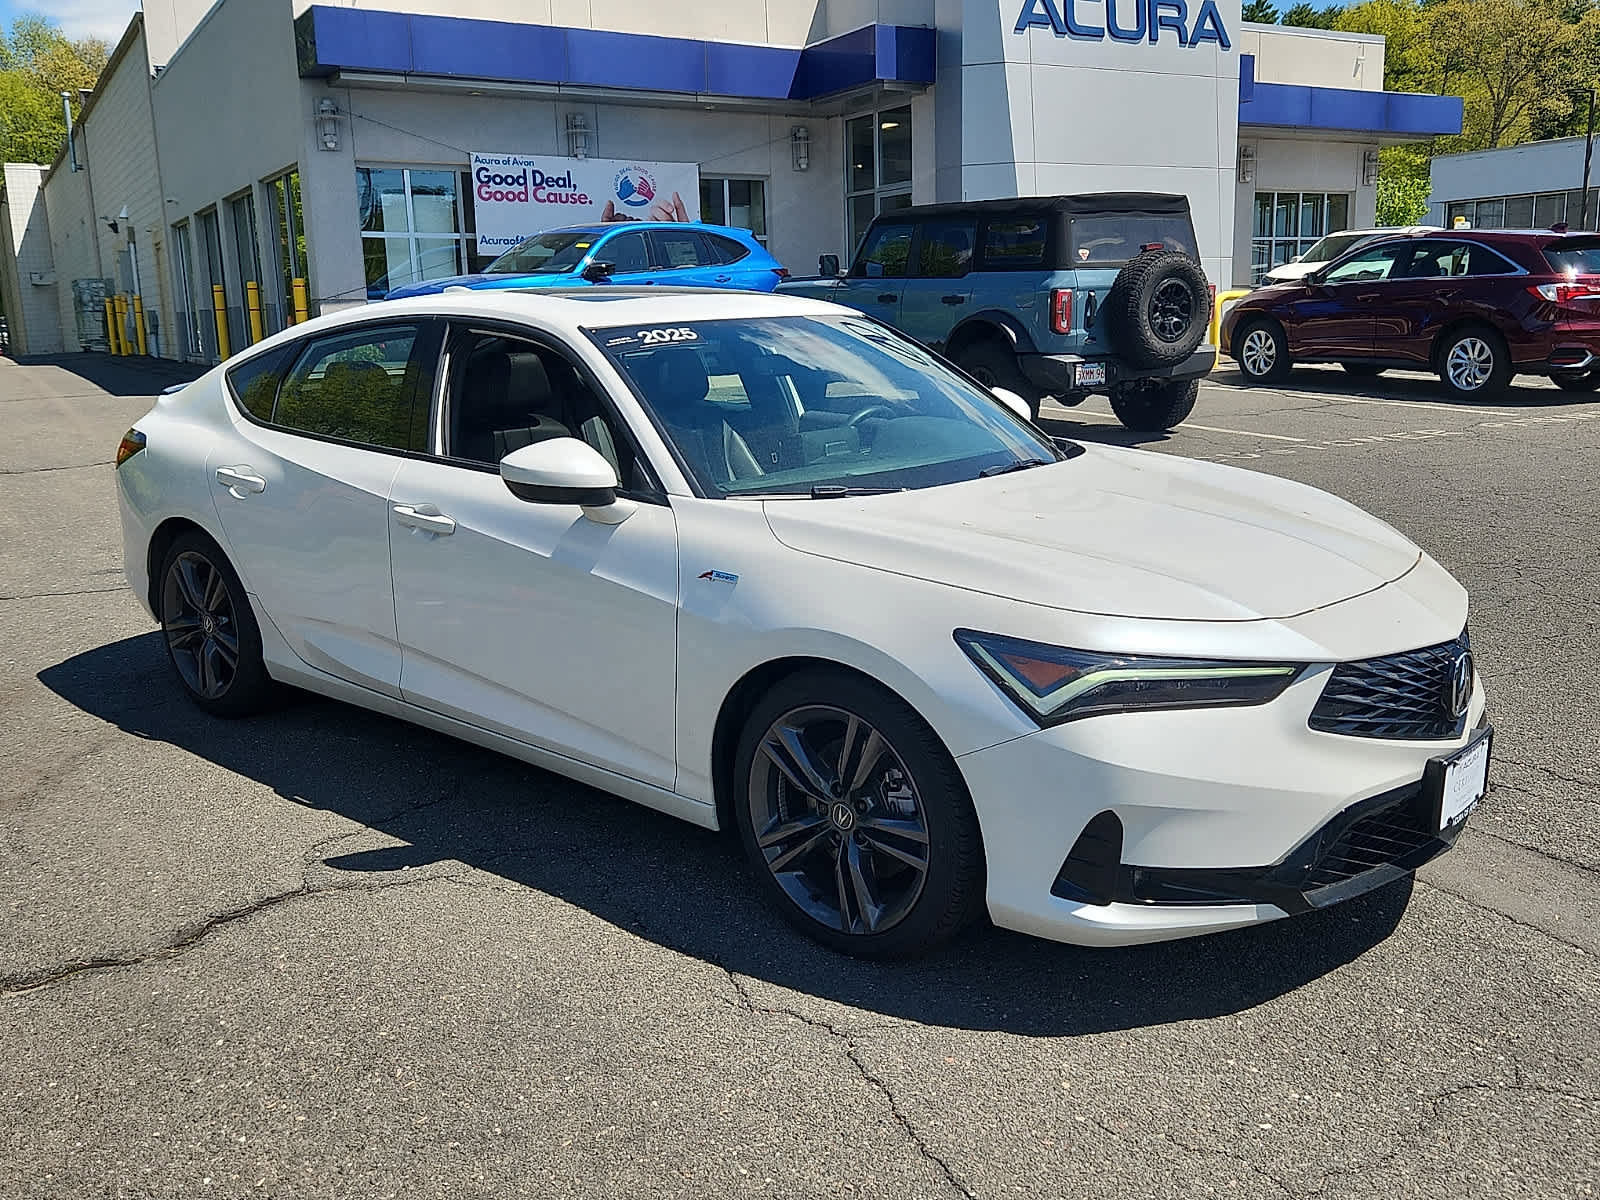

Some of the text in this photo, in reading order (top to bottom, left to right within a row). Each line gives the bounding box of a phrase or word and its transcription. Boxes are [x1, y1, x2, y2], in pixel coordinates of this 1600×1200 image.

[1013, 0, 1232, 50] ACURA
[474, 154, 535, 167] Acura of Avon
[475, 166, 578, 192] Good Deal,
[477, 183, 593, 206] Good Cause.
[637, 327, 698, 344] 2025
